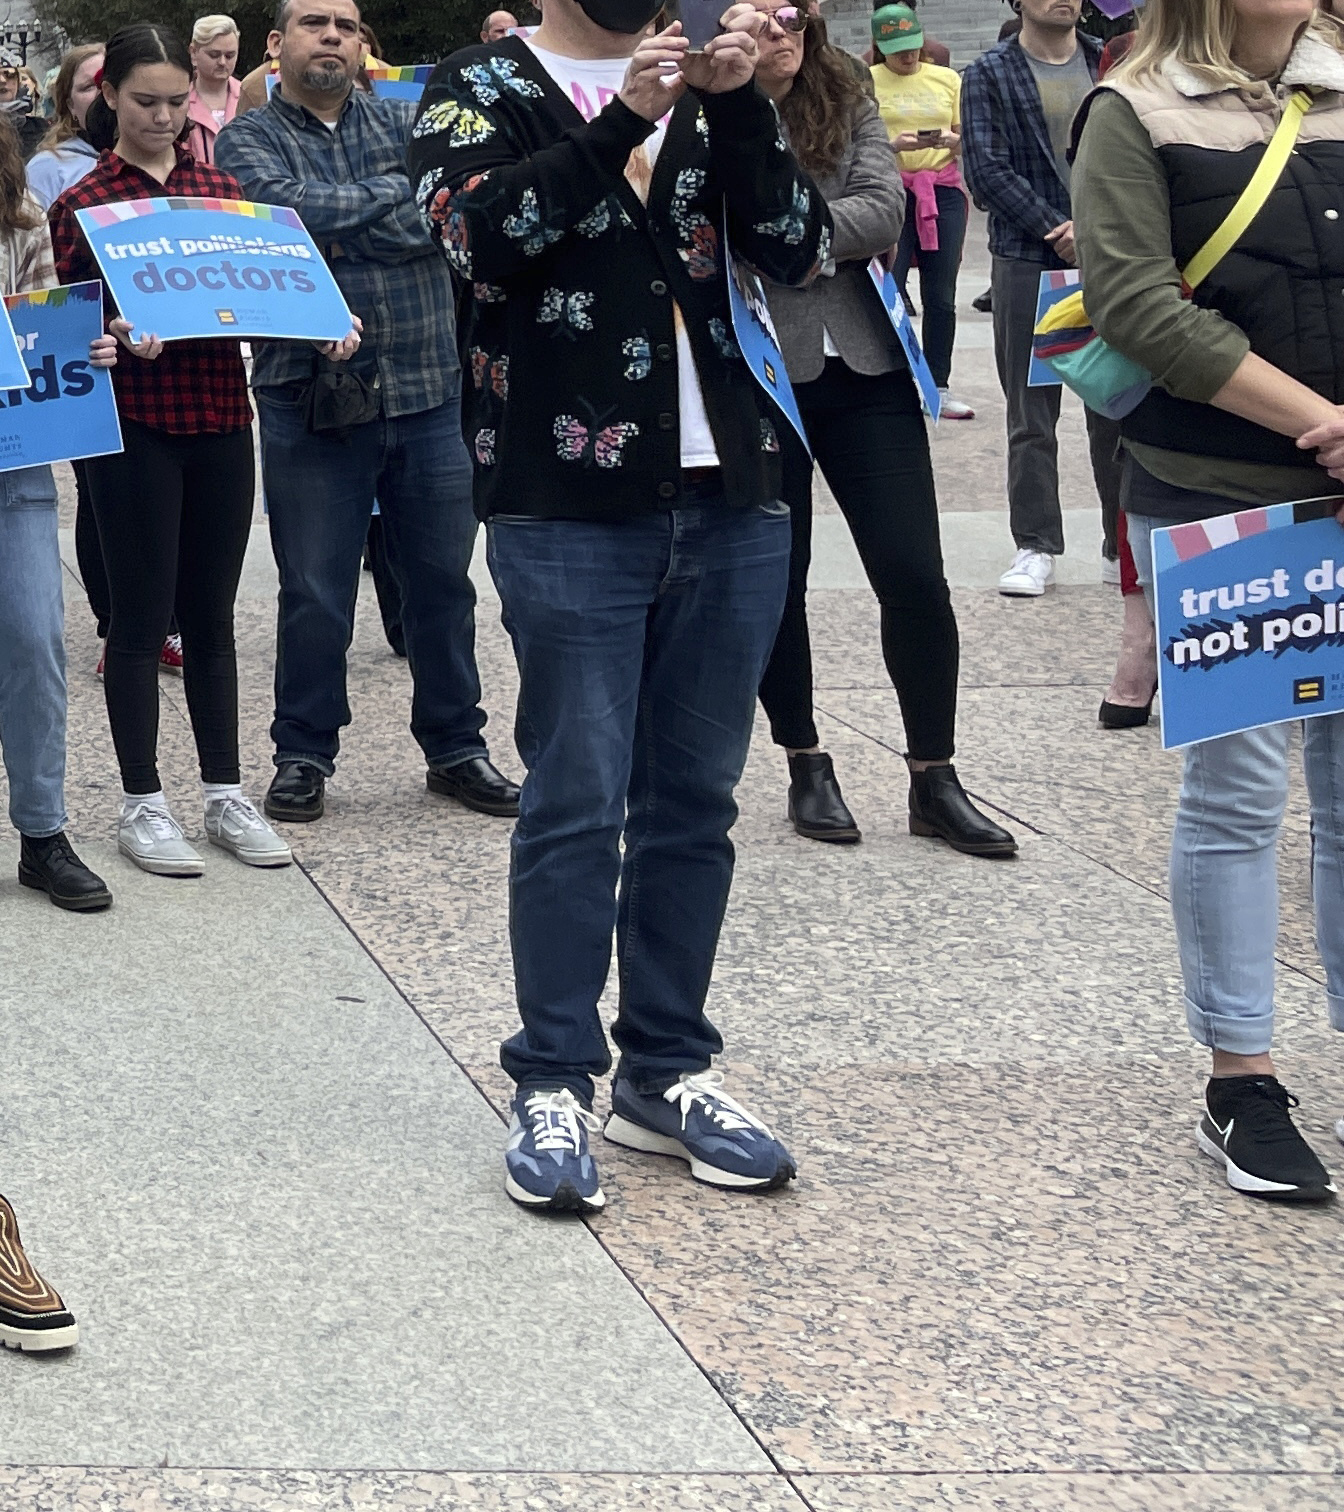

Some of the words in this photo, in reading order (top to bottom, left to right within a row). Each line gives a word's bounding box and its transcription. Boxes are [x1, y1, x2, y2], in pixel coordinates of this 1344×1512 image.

[104, 236, 175, 262] trust
[181, 236, 312, 264] politicians
[133, 260, 316, 294] doctors
[1179, 568, 1290, 619] trust
[1172, 620, 1249, 666] not
